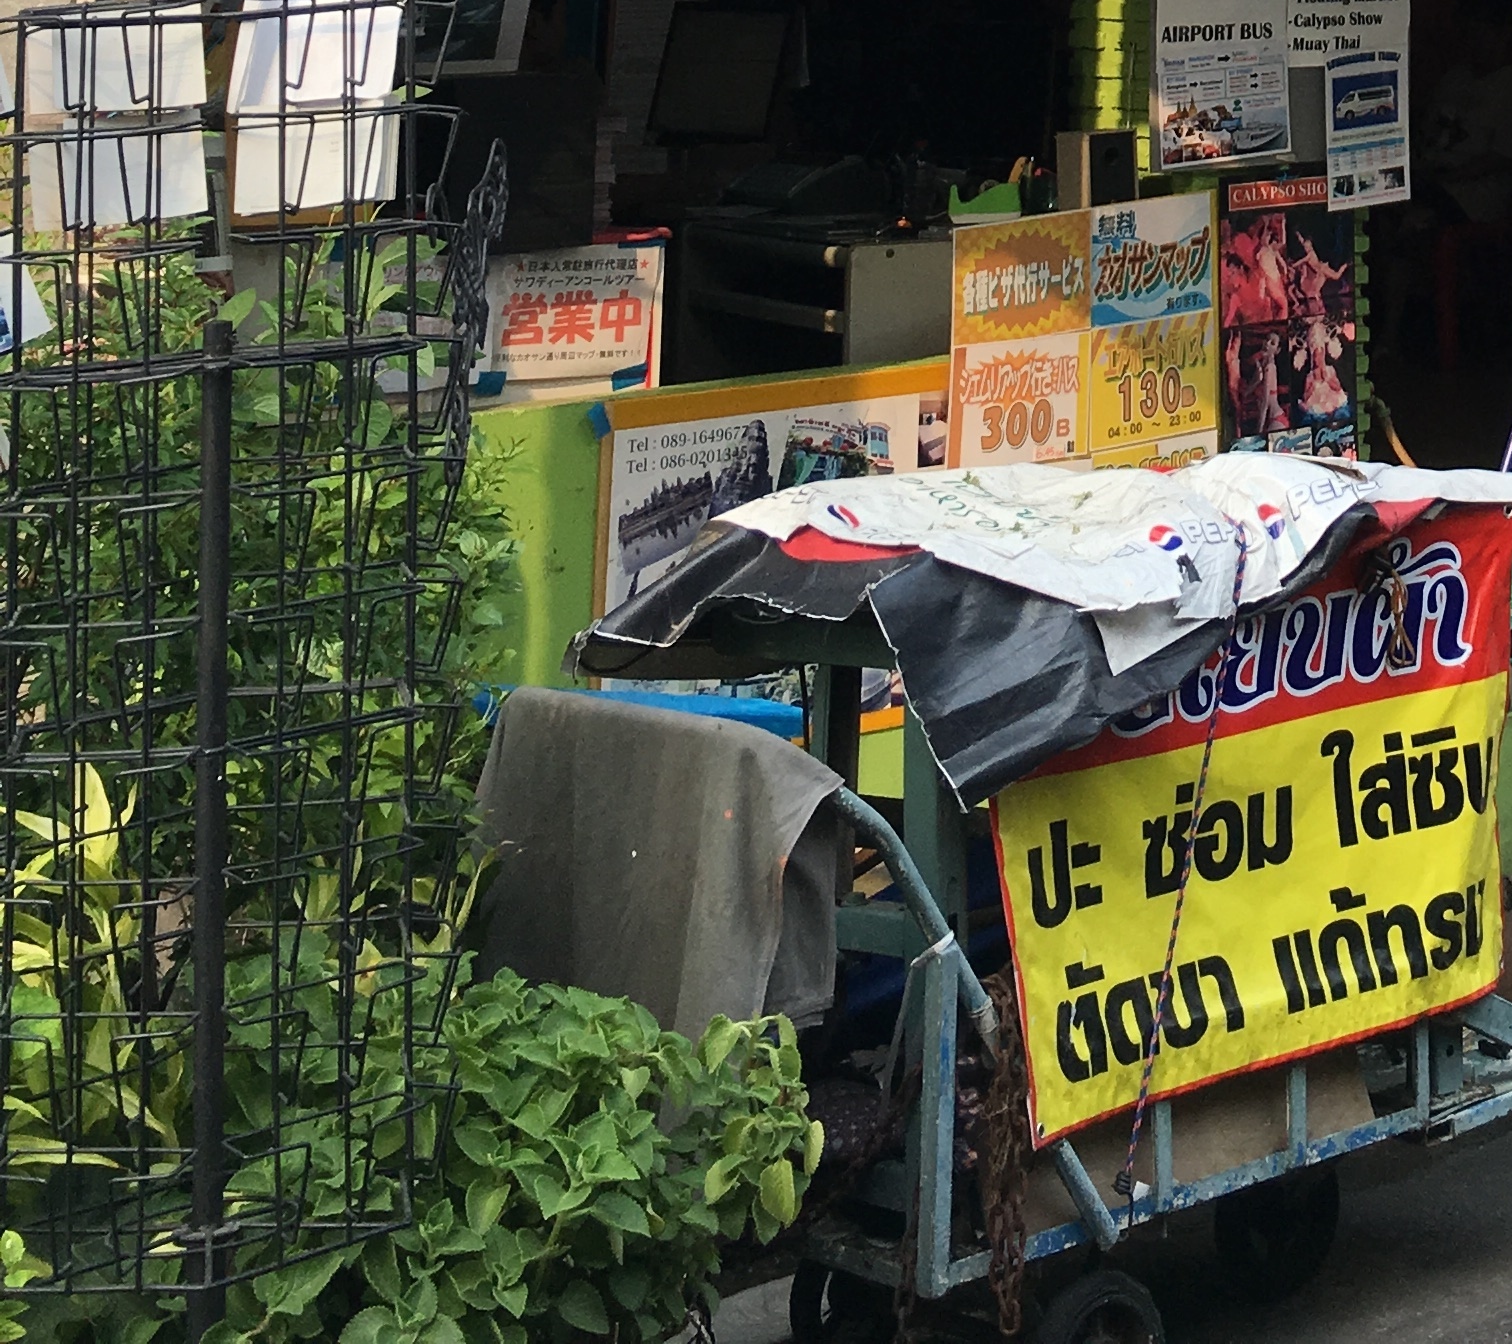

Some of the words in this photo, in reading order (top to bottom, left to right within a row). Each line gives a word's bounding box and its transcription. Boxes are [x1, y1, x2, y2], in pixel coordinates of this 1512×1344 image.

[1350, 10, 1384, 27] Show
[1161, 22, 1236, 44] AIRPORT
[1239, 21, 1274, 41] BUS
[1334, 34, 1362, 50] Thai
[1232, 181, 1297, 204] CALYPSO
[1299, 178, 1327, 198] SHO
[1097, 210, 1138, 239] 無料
[961, 255, 1086, 315] 各種ビザ代行サービス
[501, 288, 643, 347] 営業中
[1117, 365, 1181, 424] 130
[980, 397, 1055, 454] 300
[1055, 420, 1071, 439] B
[627, 437, 649, 454] Tel
[626, 458, 648, 475] Tel
[1027, 819, 1103, 929] ปะ
